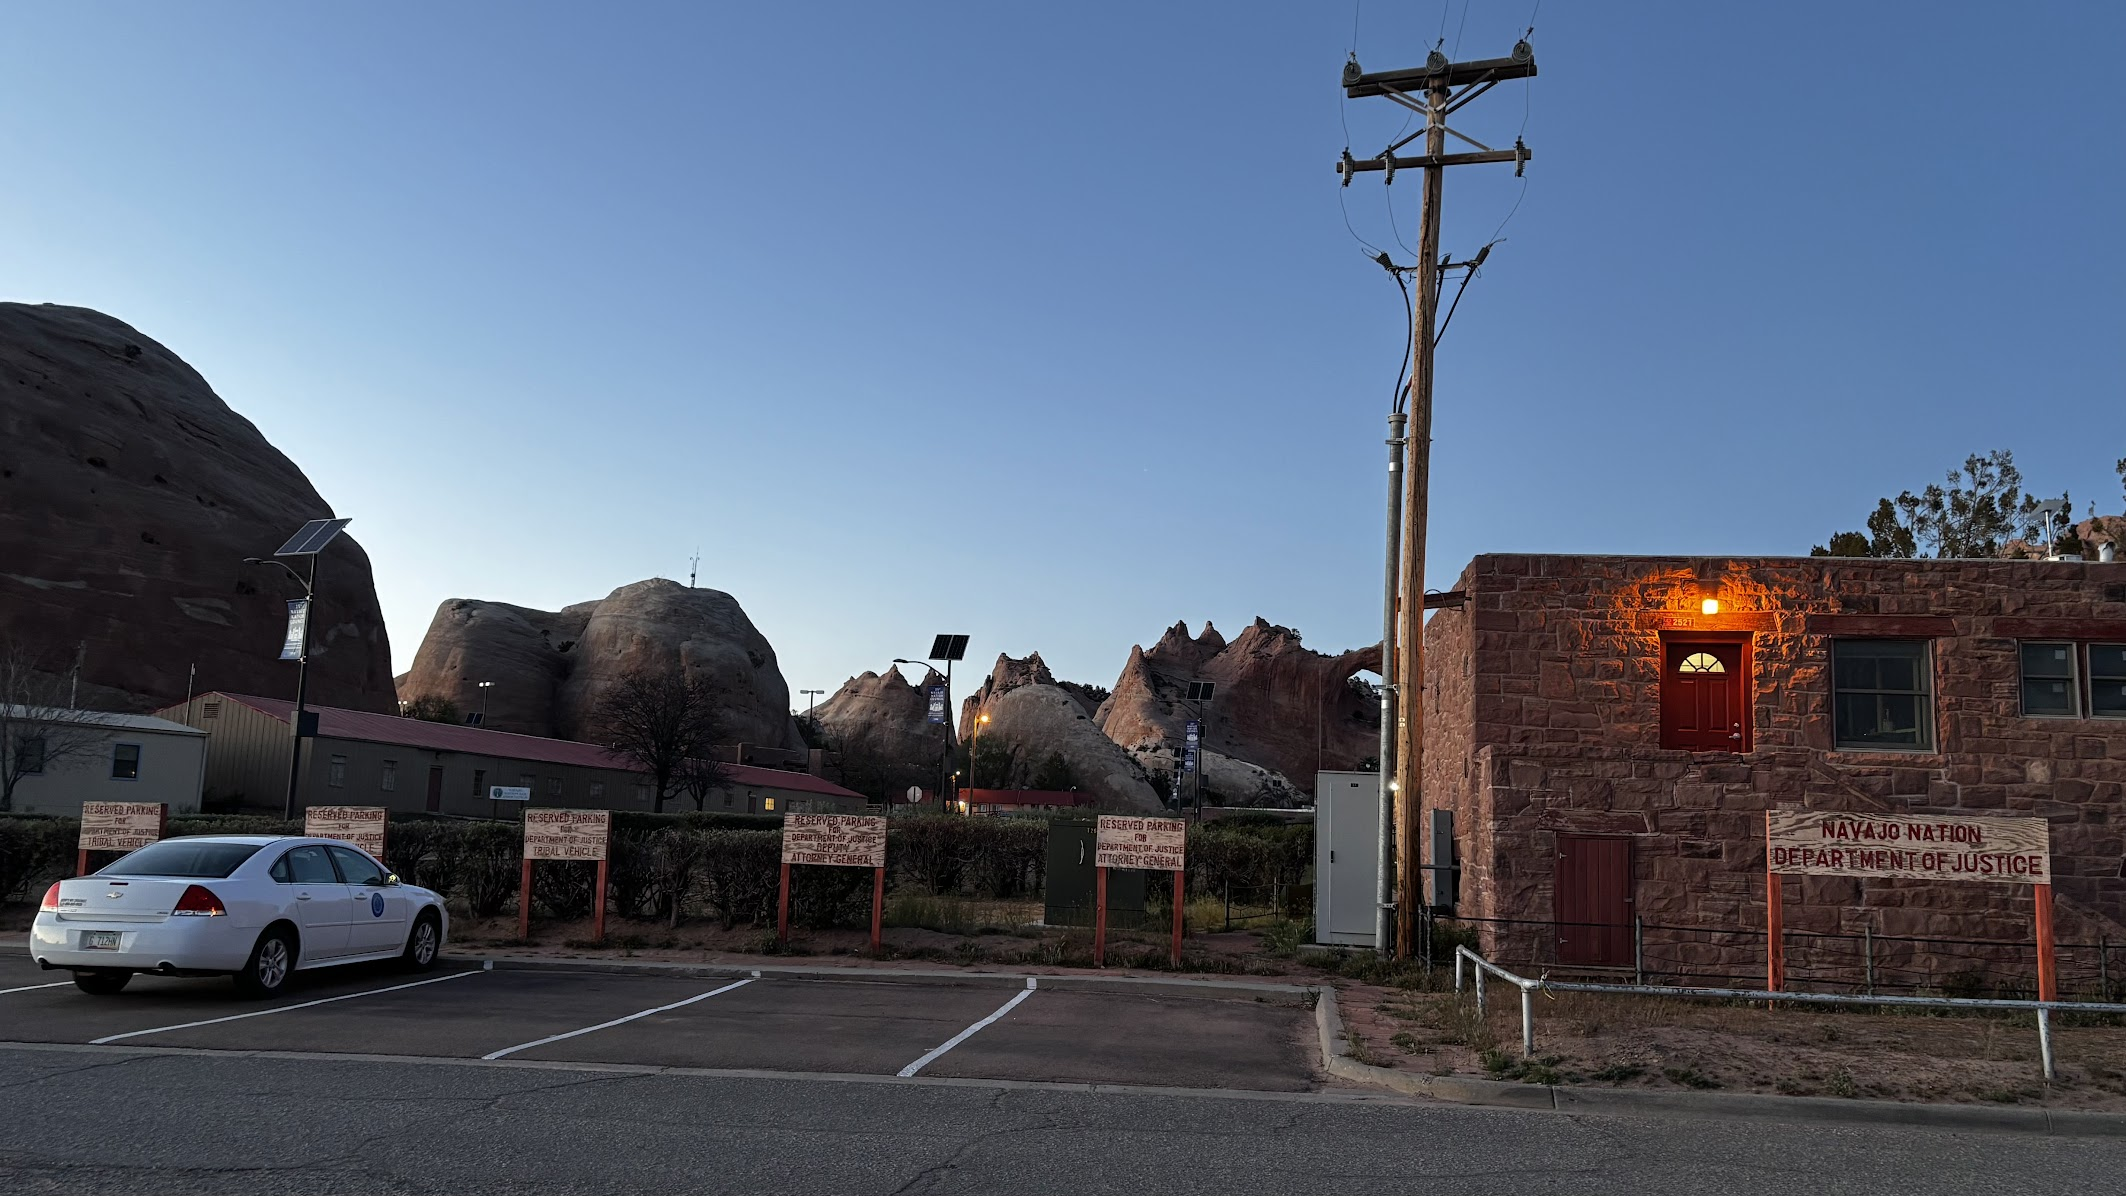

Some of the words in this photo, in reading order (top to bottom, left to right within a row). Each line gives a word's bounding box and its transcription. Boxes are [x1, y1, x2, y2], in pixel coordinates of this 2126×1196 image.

[1673, 618, 1692, 627] 2521
[84, 804, 125, 815] RESERVED
[126, 805, 159, 815] PARKING
[308, 810, 348, 820] RESERVED
[350, 811, 383, 820] PARKING
[527, 813, 569, 823] RESERVED
[572, 814, 606, 824] PARKING
[794, 815, 838, 826] RESERVED
[841, 817, 876, 827] PARKING
[1100, 819, 1144, 830] RESERVED
[1146, 821, 1183, 832] PARKING
[1134, 833, 1147, 842] FOR
[1821, 821, 1900, 841] NAVAJO
[1907, 822, 1982, 843] NATION
[88, 837, 114, 847] TRIBAL
[525, 835, 567, 844] DEPARTMENT
[568, 836, 576, 844] OF
[579, 836, 607, 845] JUSTICE
[791, 833, 835, 842] DEPARTMENT
[837, 834, 846, 843] OF
[846, 836, 877, 844] JUSTICE
[533, 846, 560, 856] TRIBAL
[564, 847, 598, 857] VEHICLE
[816, 843, 850, 853] DEPUTY
[1097, 842, 1142, 852] DEPARTMENT
[1144, 844, 1153, 852] OF
[1155, 846, 1184, 854] JUSTICE
[791, 853, 835, 863] ATTORNEY
[836, 854, 874, 865] GENERAL
[1097, 854, 1140, 865] ATTORNEY
[1143, 856, 1182, 868] GENERAL
[1774, 847, 1916, 871] DEPARTMENT
[1921, 851, 1947, 871] OF
[1951, 853, 2044, 876] JUSTICE
